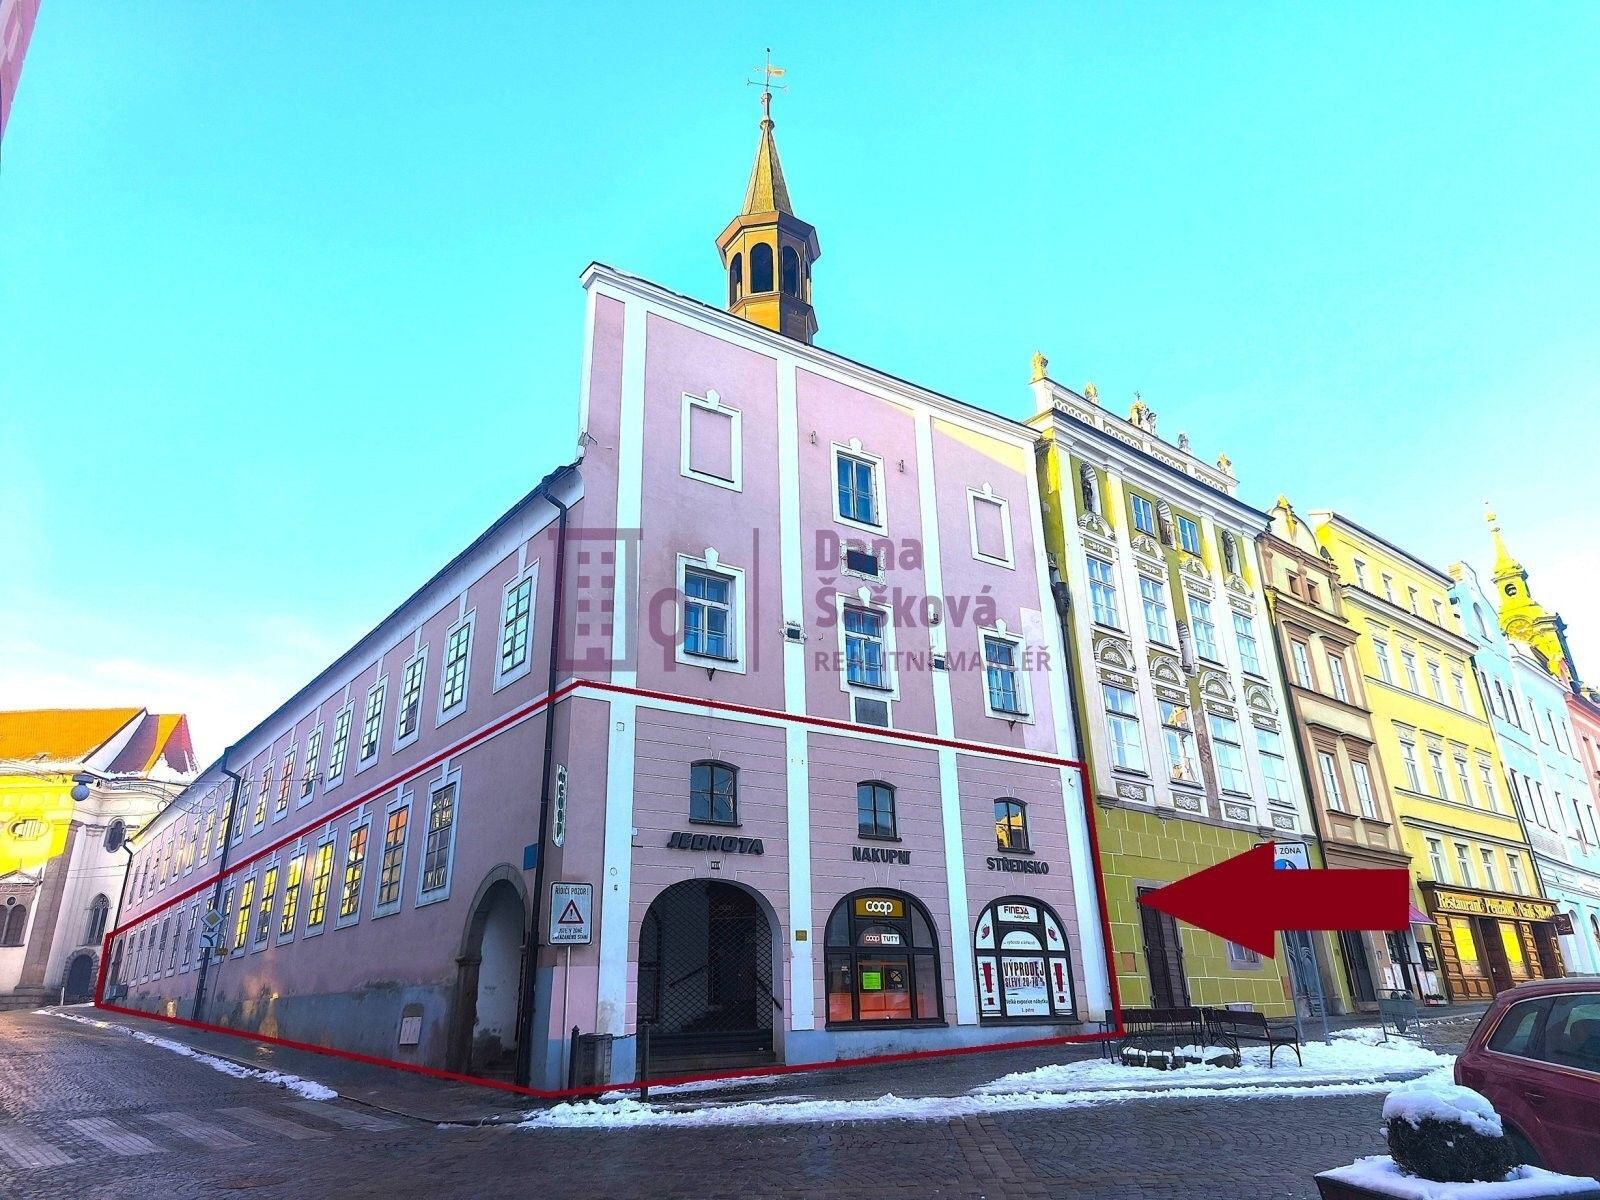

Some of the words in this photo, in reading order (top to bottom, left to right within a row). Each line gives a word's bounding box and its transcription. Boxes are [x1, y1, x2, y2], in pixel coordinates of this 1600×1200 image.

[667, 831, 765, 855] JEDNOTA
[1279, 846, 1302, 855] ZÓNA
[986, 857, 1050, 875] STŘEDISKO
[865, 901, 893, 915] coop
[1436, 890, 1484, 912] Restaurant
[1003, 960, 1045, 977] VÝPRODEJ
[1004, 977, 1021, 988] SLEVY
